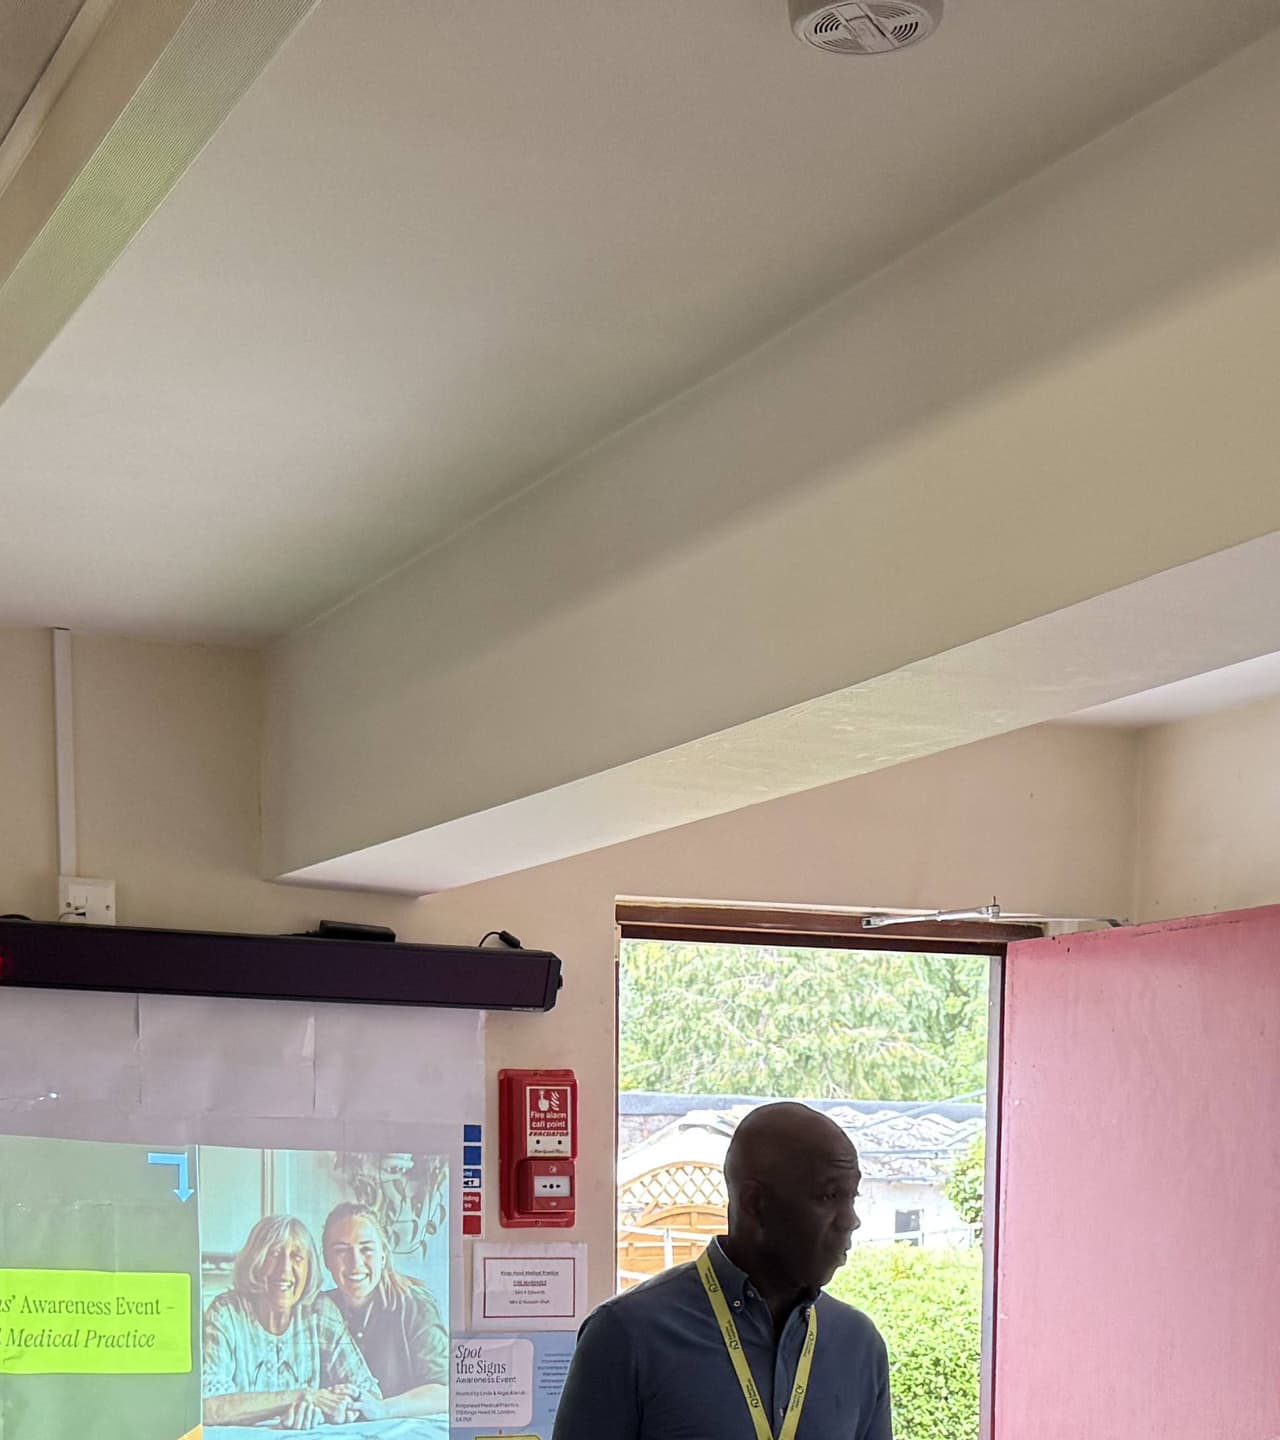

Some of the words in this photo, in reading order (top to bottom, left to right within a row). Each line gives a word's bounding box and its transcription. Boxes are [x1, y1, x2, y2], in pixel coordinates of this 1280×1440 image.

[530, 1111, 545, 1119] Fire
[546, 1111, 567, 1119] alarm
[532, 1120, 545, 1128] call
[547, 1120, 566, 1129] point
[20, 1296, 112, 1315] Awareness
[116, 1297, 161, 1315] Event
[5, 1328, 80, 1349] Medical
[83, 1329, 156, 1349] Practice
[455, 1344, 482, 1361] Spot
[456, 1359, 474, 1375] the
[476, 1359, 506, 1377] Signs
[456, 1376, 495, 1384] Awareness
